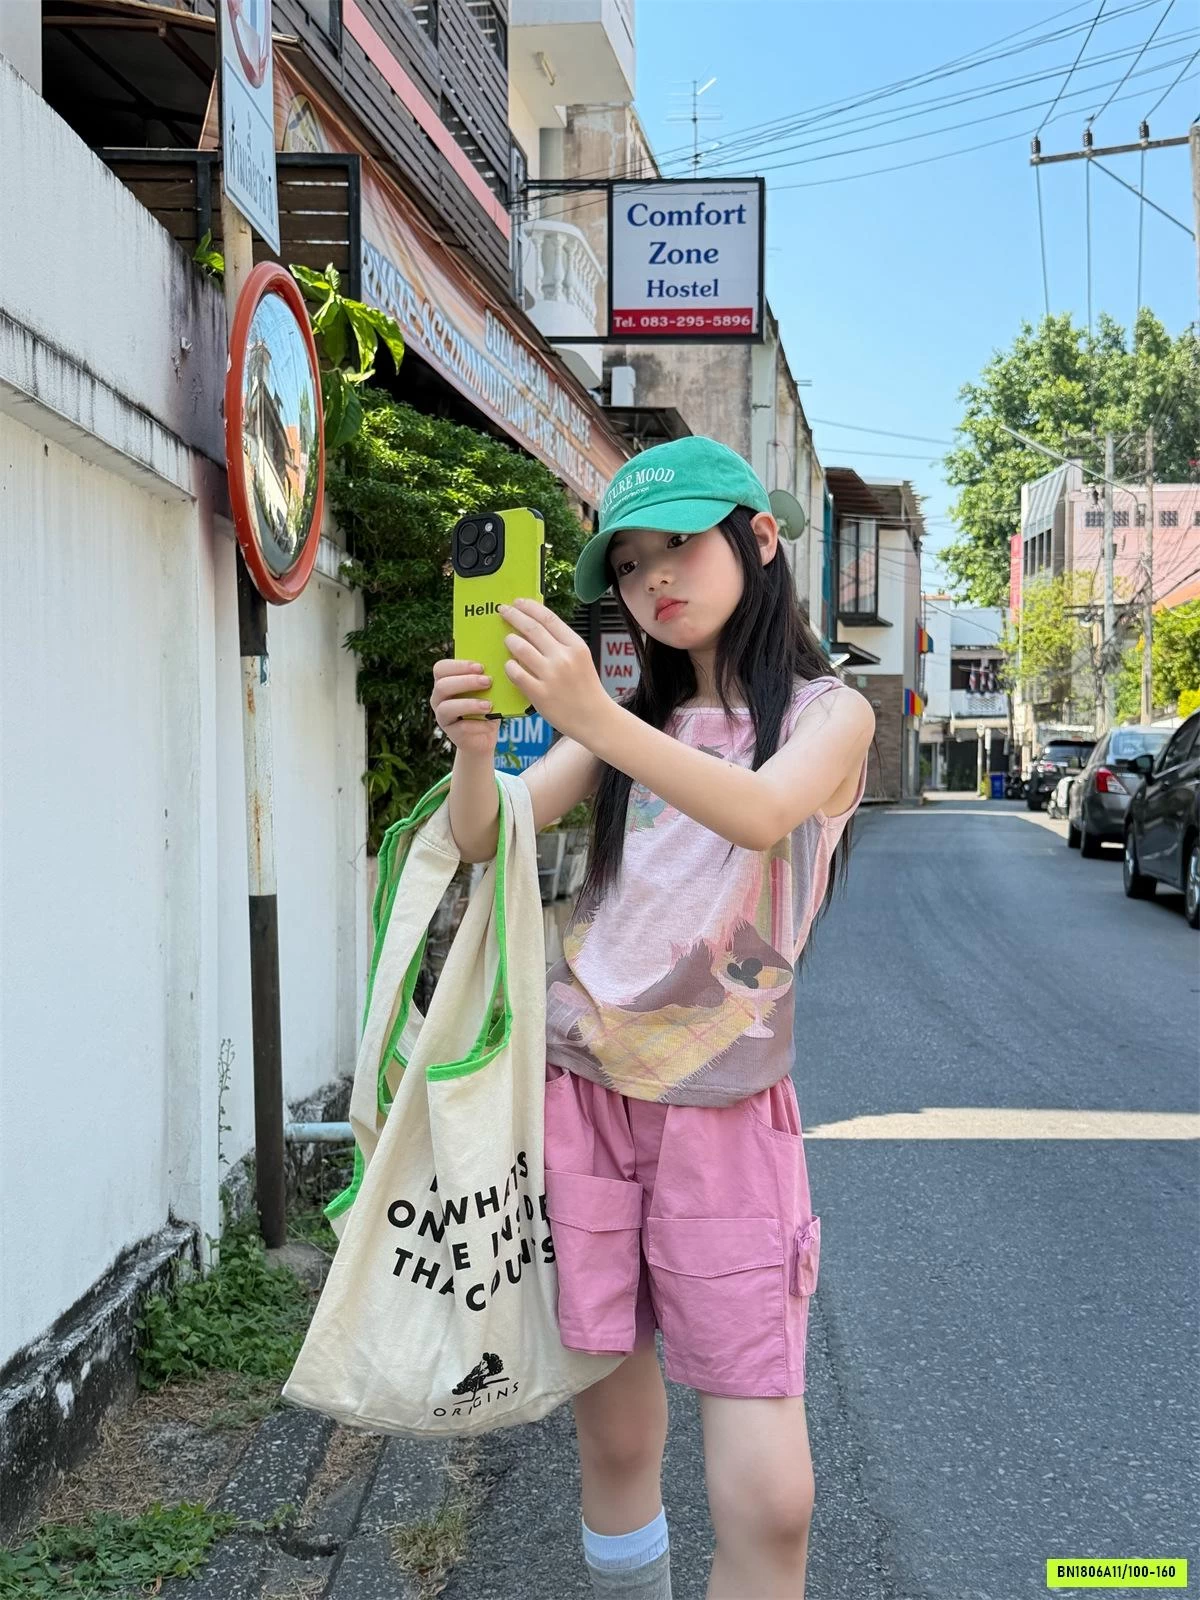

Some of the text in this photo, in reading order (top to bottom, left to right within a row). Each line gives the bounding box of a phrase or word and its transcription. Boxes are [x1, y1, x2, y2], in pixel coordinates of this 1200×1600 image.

[627, 202, 747, 227] Comfort
[649, 241, 719, 265] Zone
[646, 278, 719, 298] Hostel
[614, 315, 751, 328] Tel. 083-295-5896
[634, 467, 675, 486] MOOD
[604, 665, 633, 678] VAN
[433, 1381, 519, 1417] ORIGINS
